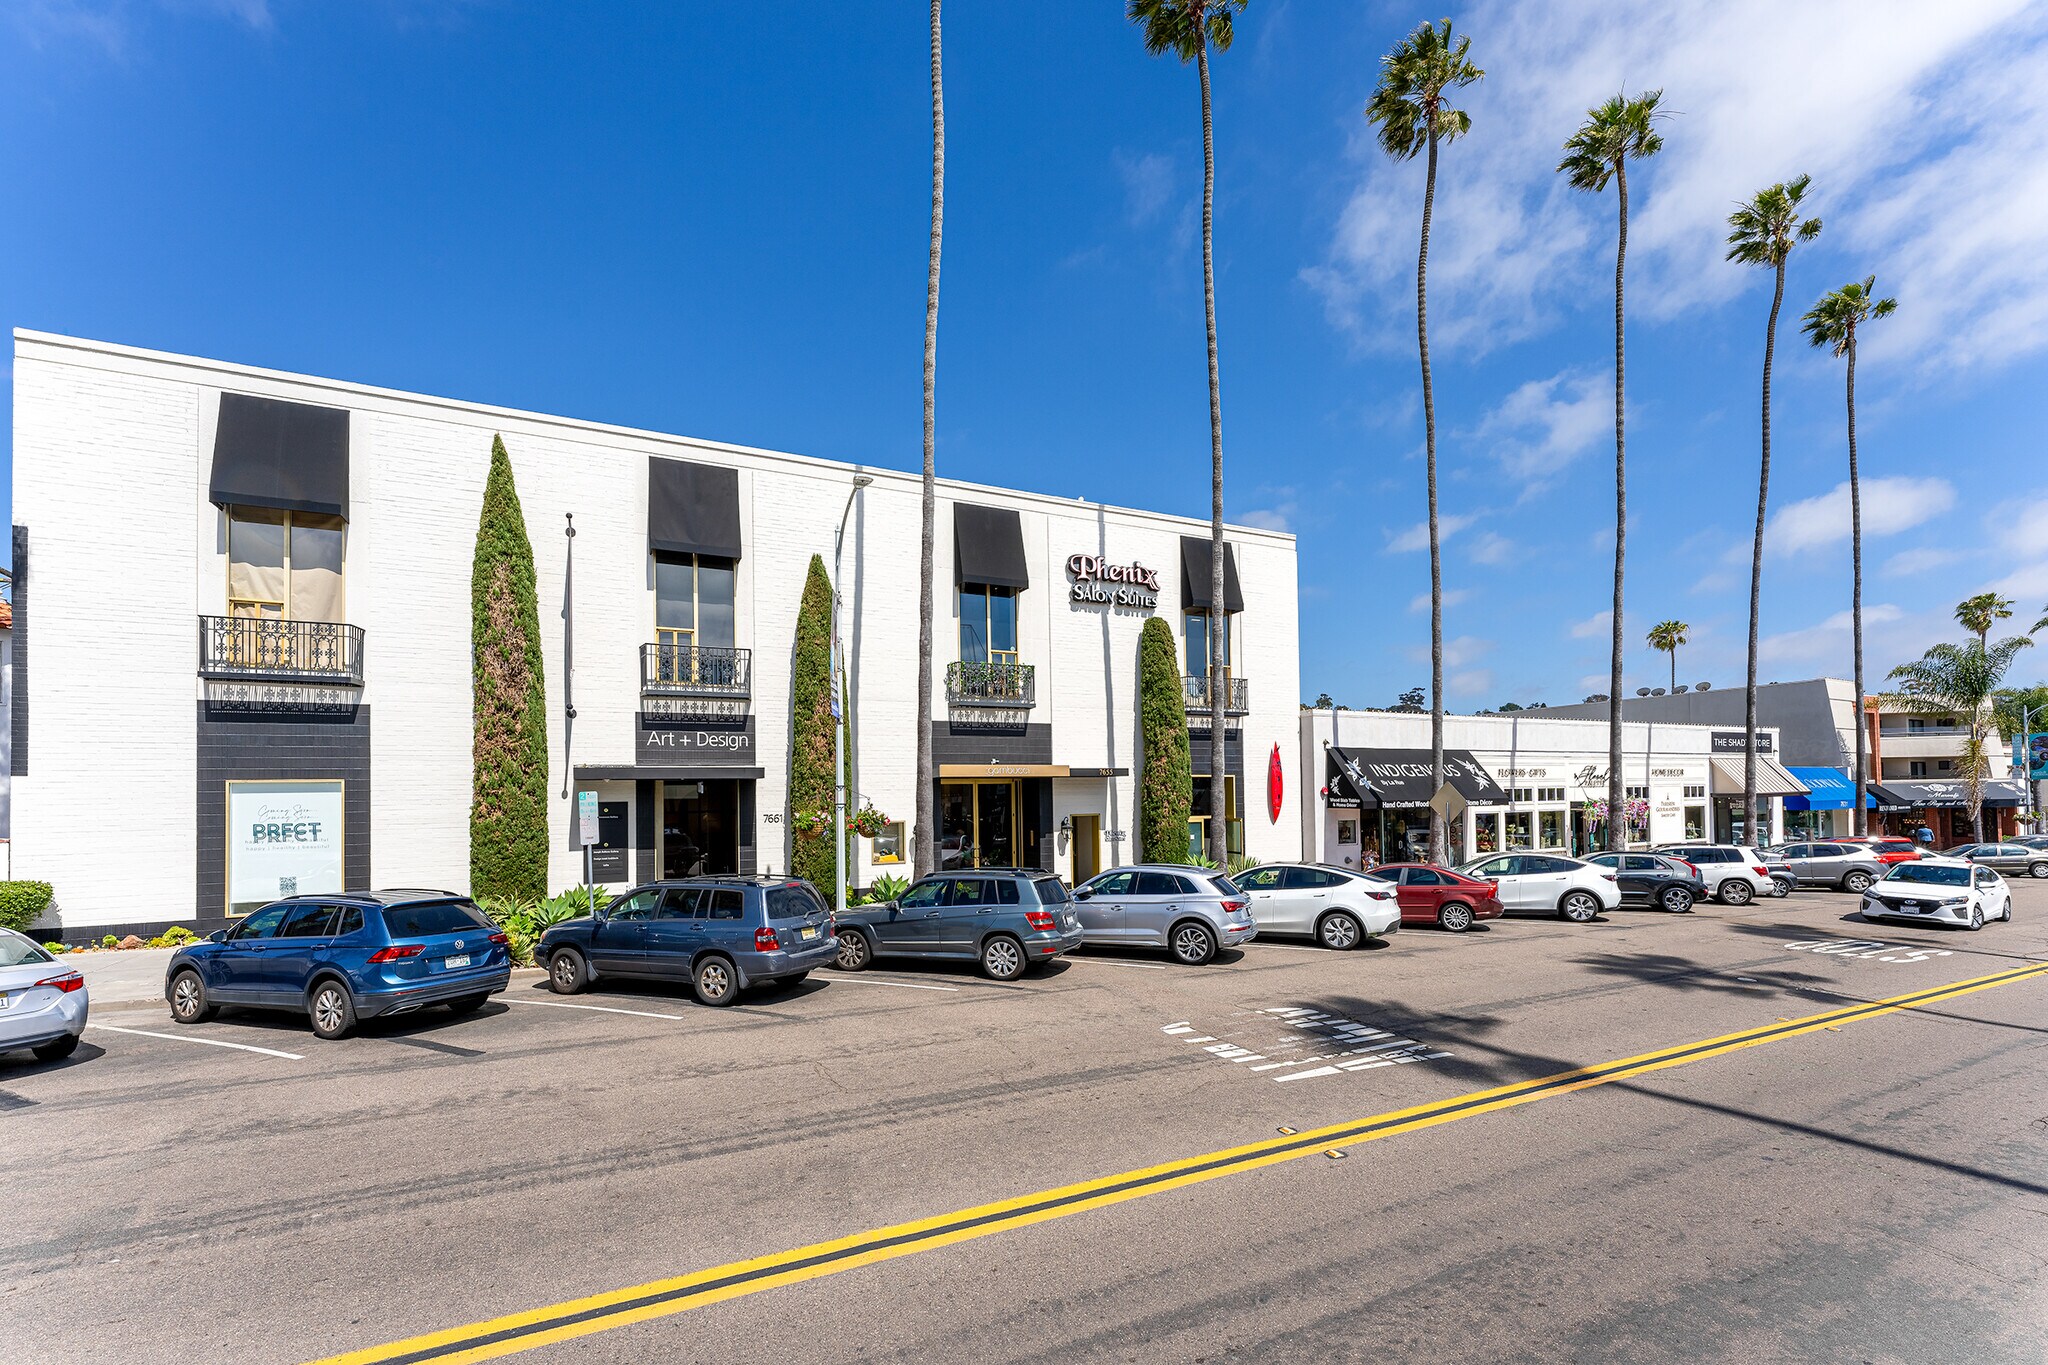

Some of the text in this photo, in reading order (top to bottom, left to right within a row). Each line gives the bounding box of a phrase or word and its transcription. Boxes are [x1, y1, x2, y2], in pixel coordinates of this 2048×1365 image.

[1068, 554, 1159, 591] Phenix
[647, 731, 748, 751] Art + Design
[1713, 738, 1727, 747] THE
[1728, 739, 1747, 747] SHAD
[1369, 764, 1461, 777] INDIGENUS
[580, 792, 586, 800] 2
[1382, 800, 1429, 809] Hand Crafted Wood
[763, 814, 783, 823] 7661
